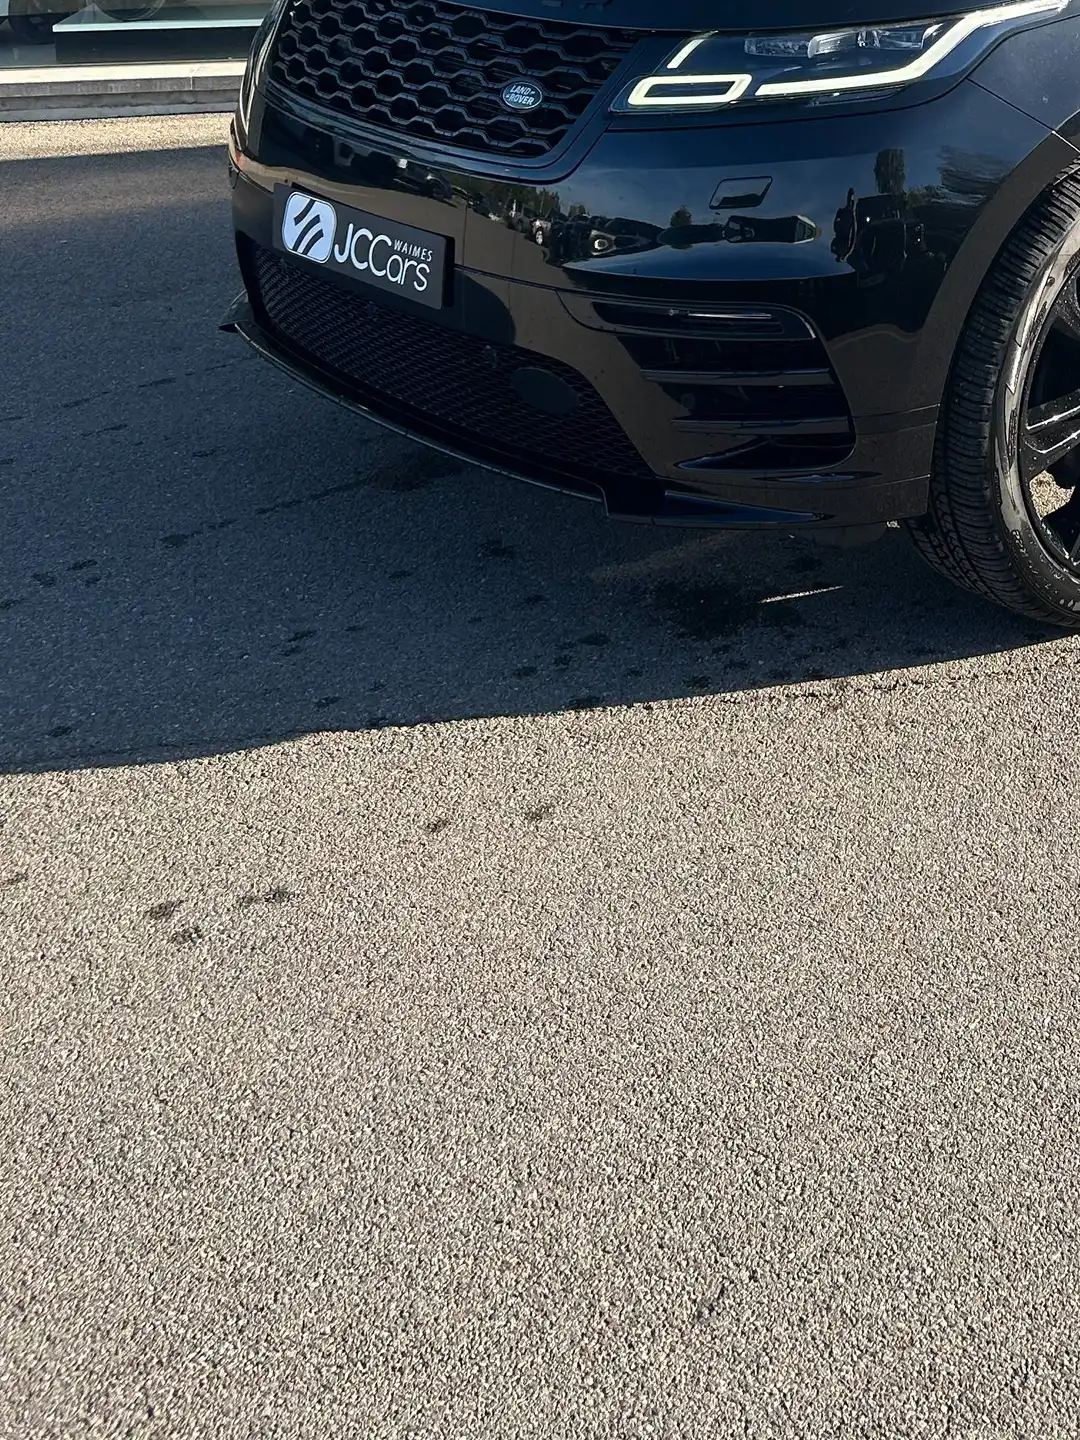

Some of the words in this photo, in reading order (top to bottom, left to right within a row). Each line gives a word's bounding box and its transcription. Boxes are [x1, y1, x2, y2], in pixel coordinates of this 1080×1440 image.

[510, 85, 531, 95] LAND
[508, 93, 535, 105] ROVER
[334, 223, 431, 292] JCCars
[393, 239, 434, 262] WAIMES
